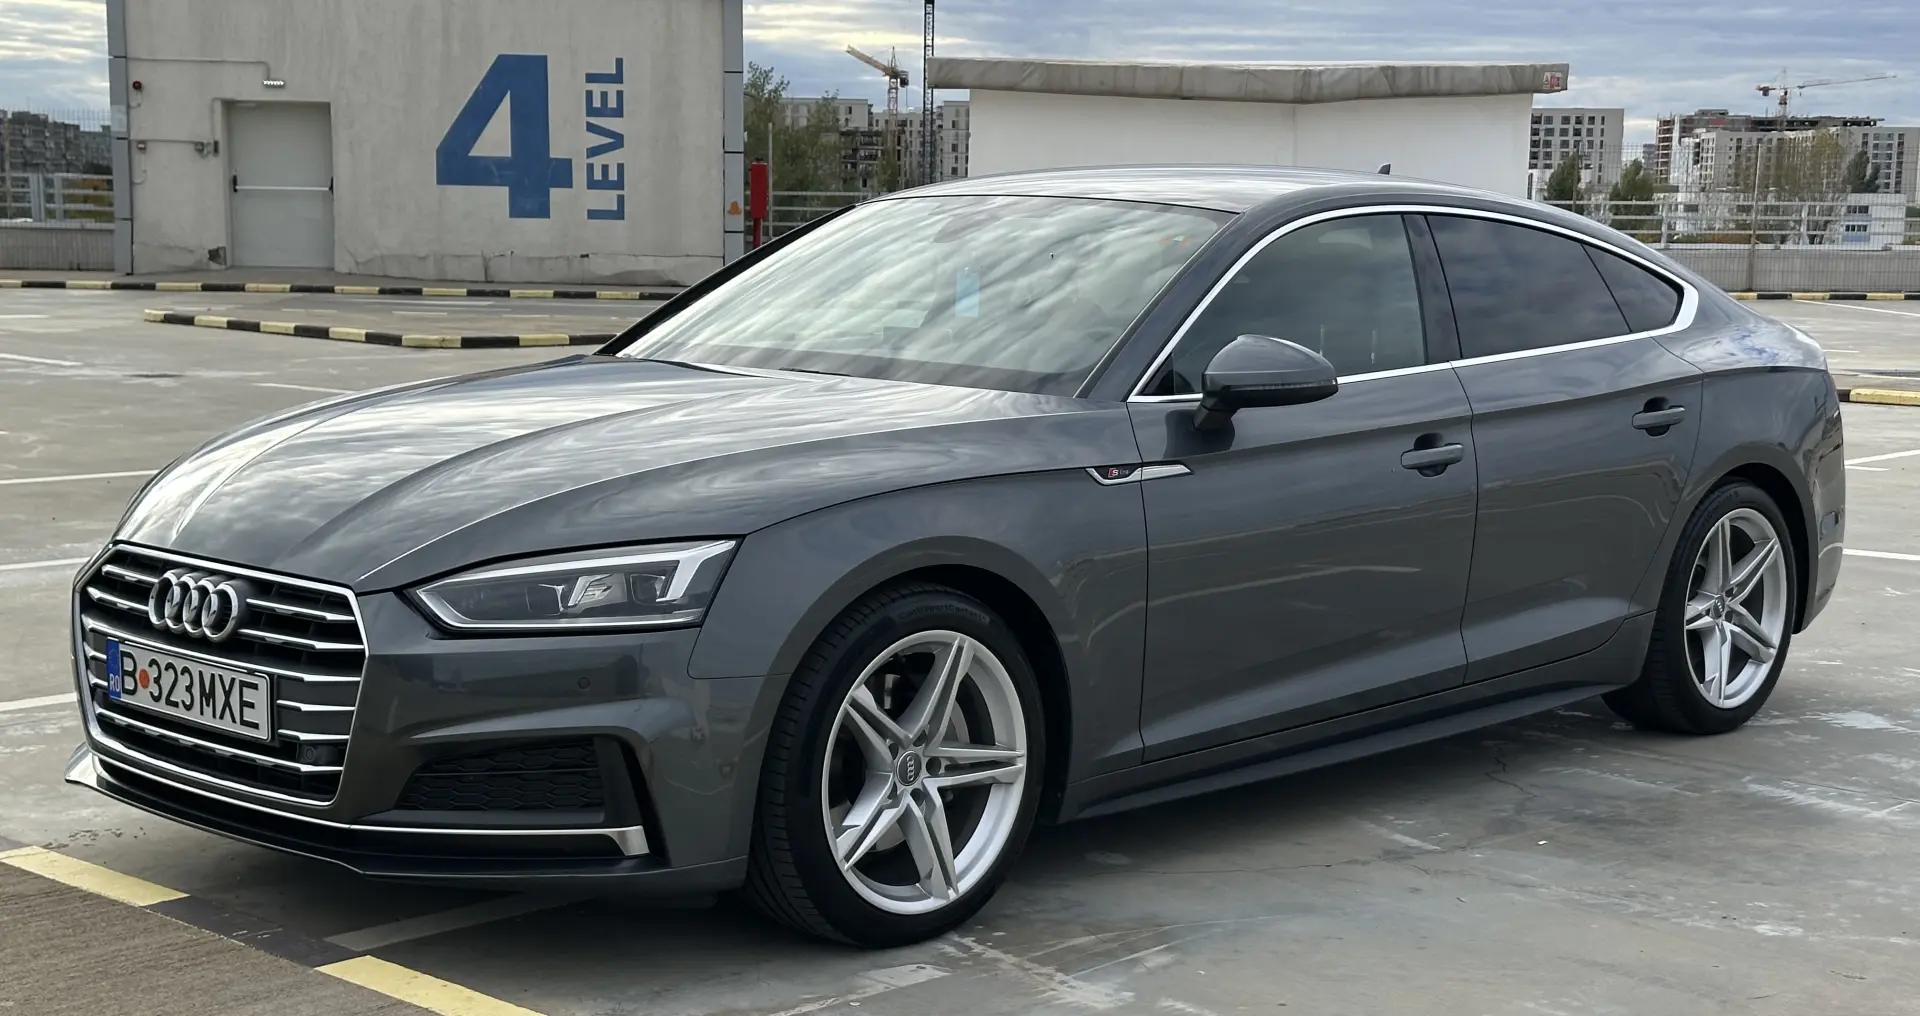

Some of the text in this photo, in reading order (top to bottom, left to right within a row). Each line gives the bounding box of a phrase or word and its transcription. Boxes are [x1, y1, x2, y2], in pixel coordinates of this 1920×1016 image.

[436, 54, 573, 219] 4
[585, 57, 625, 220] LEVEL
[109, 673, 120, 692] RO
